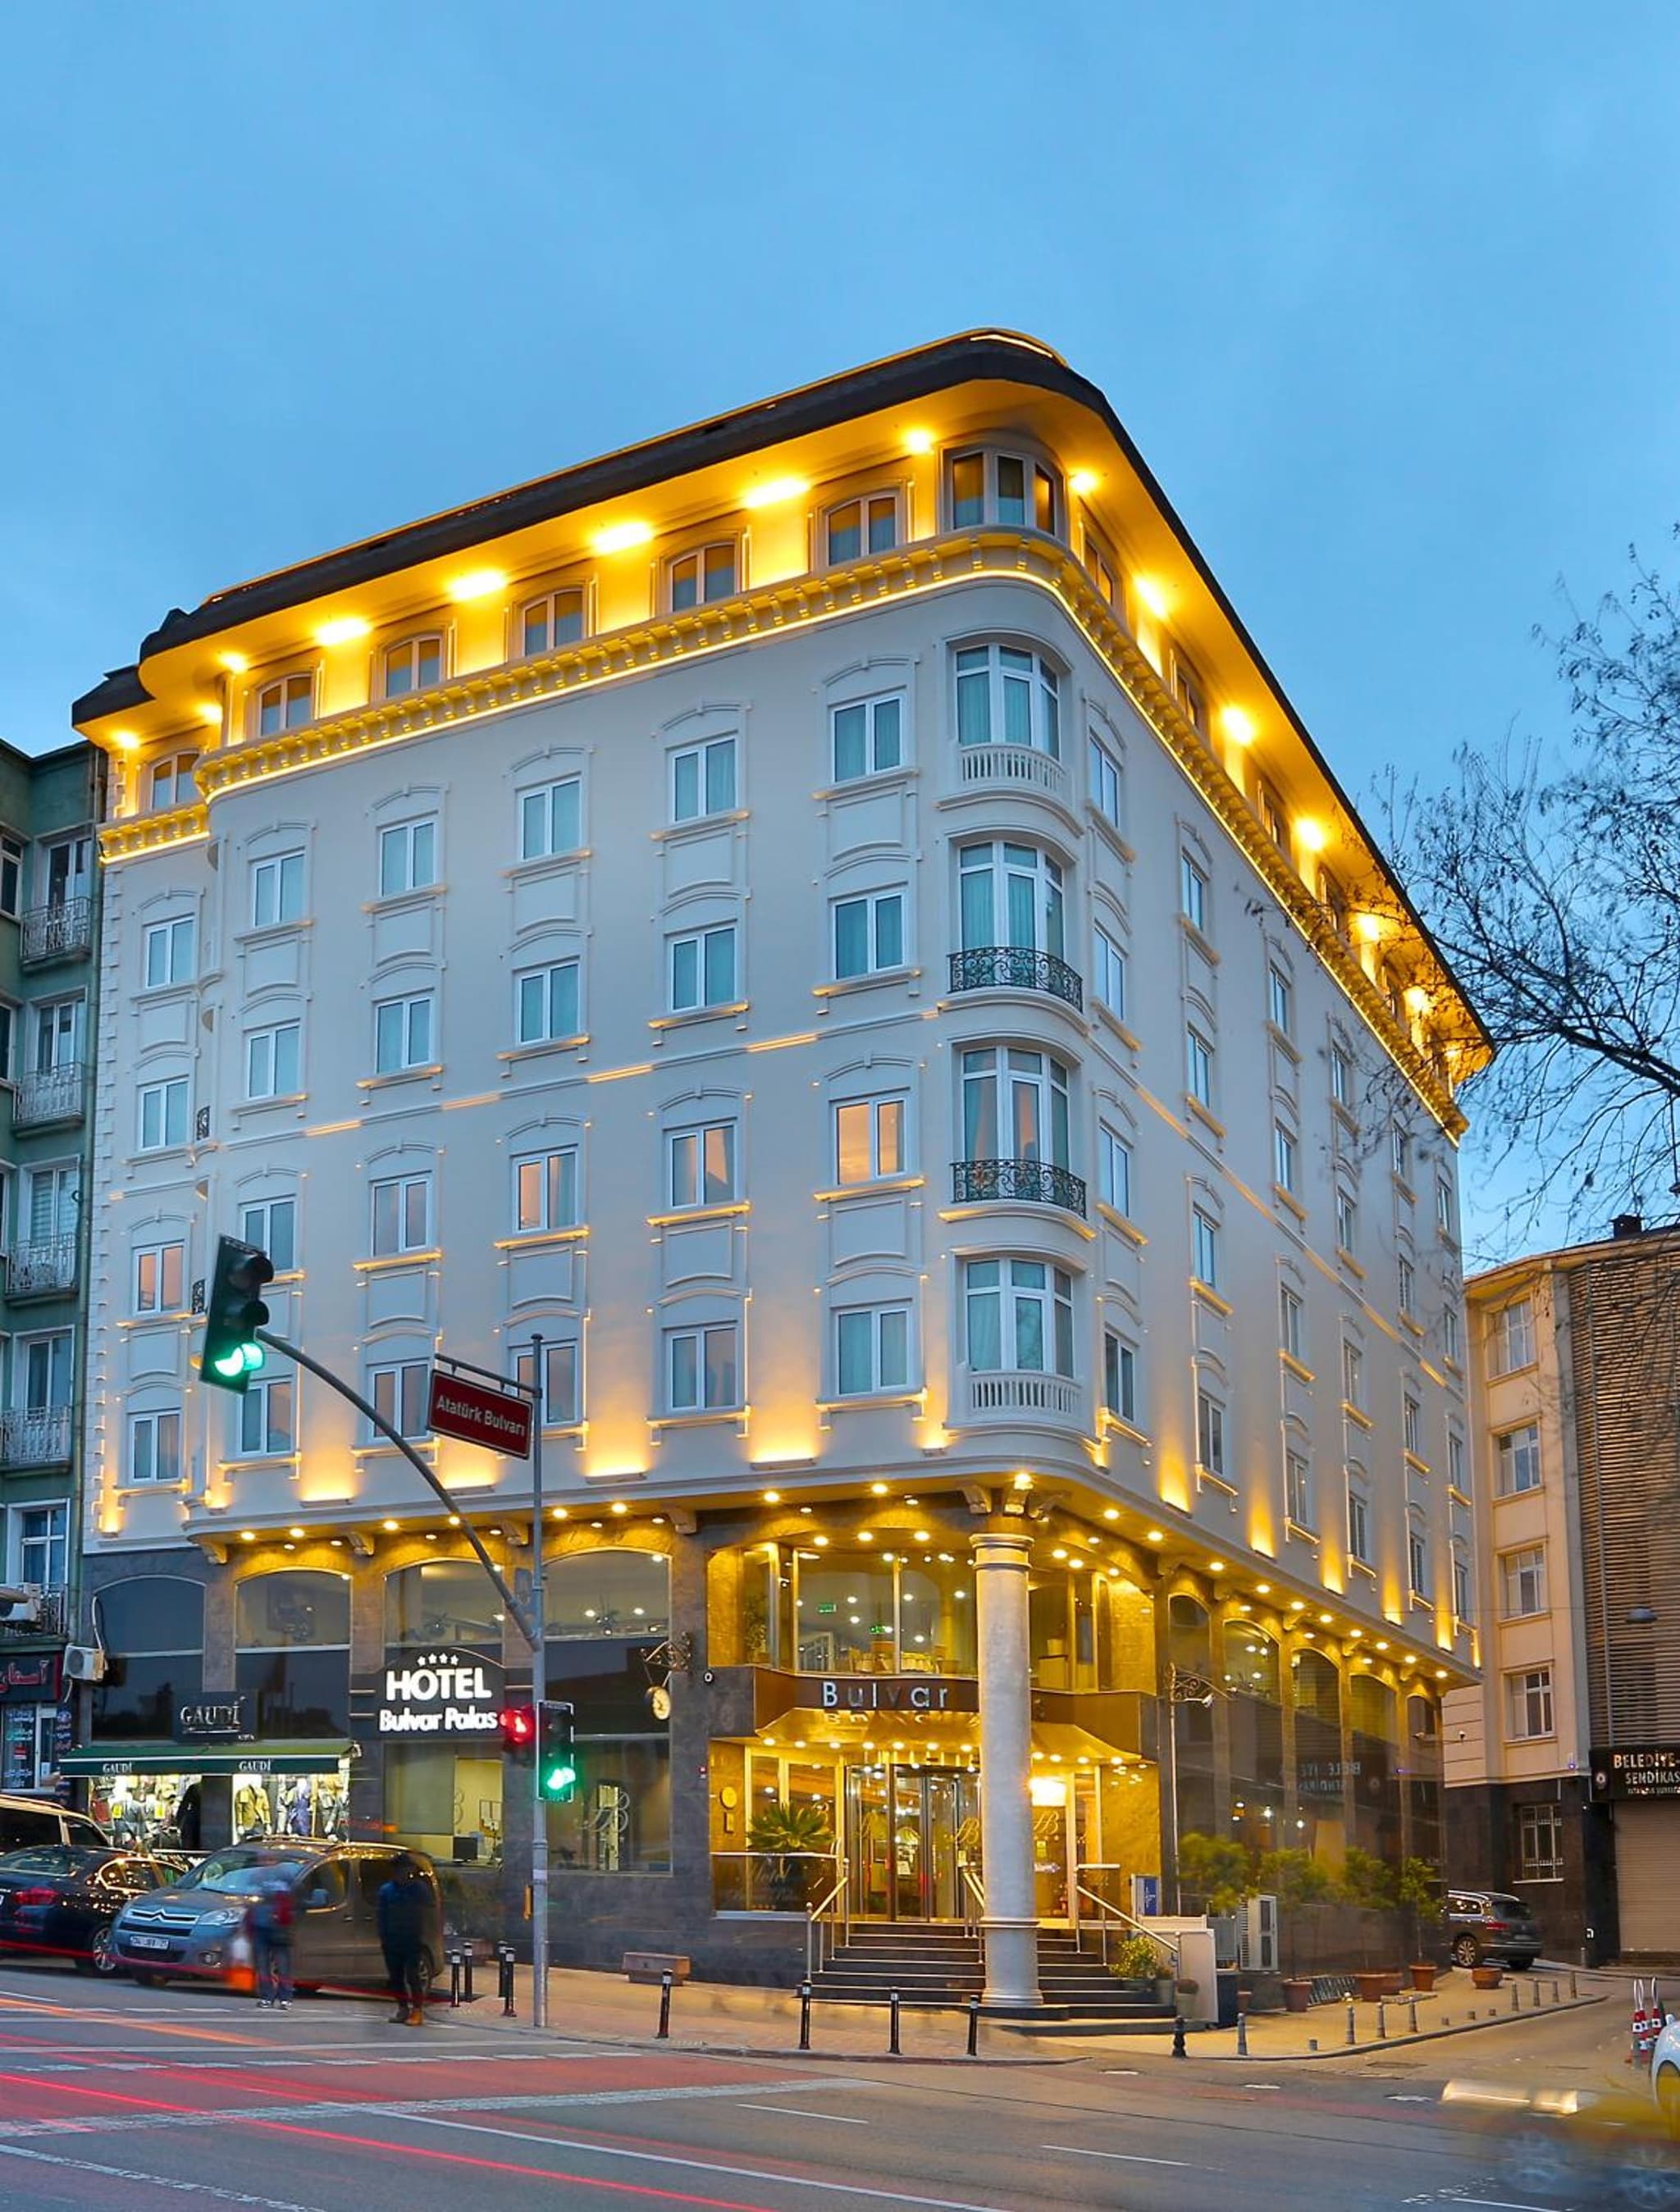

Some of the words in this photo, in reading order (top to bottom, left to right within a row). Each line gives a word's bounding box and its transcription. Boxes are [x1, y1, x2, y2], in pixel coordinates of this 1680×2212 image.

[436, 1395, 482, 1423] Atatürk
[484, 1409, 525, 1437] Bulvarı
[386, 1667, 492, 1701] HOTEL
[823, 1682, 947, 1708] Bulvar
[379, 1707, 443, 1731] Bulvar
[445, 1705, 499, 1730] Palas
